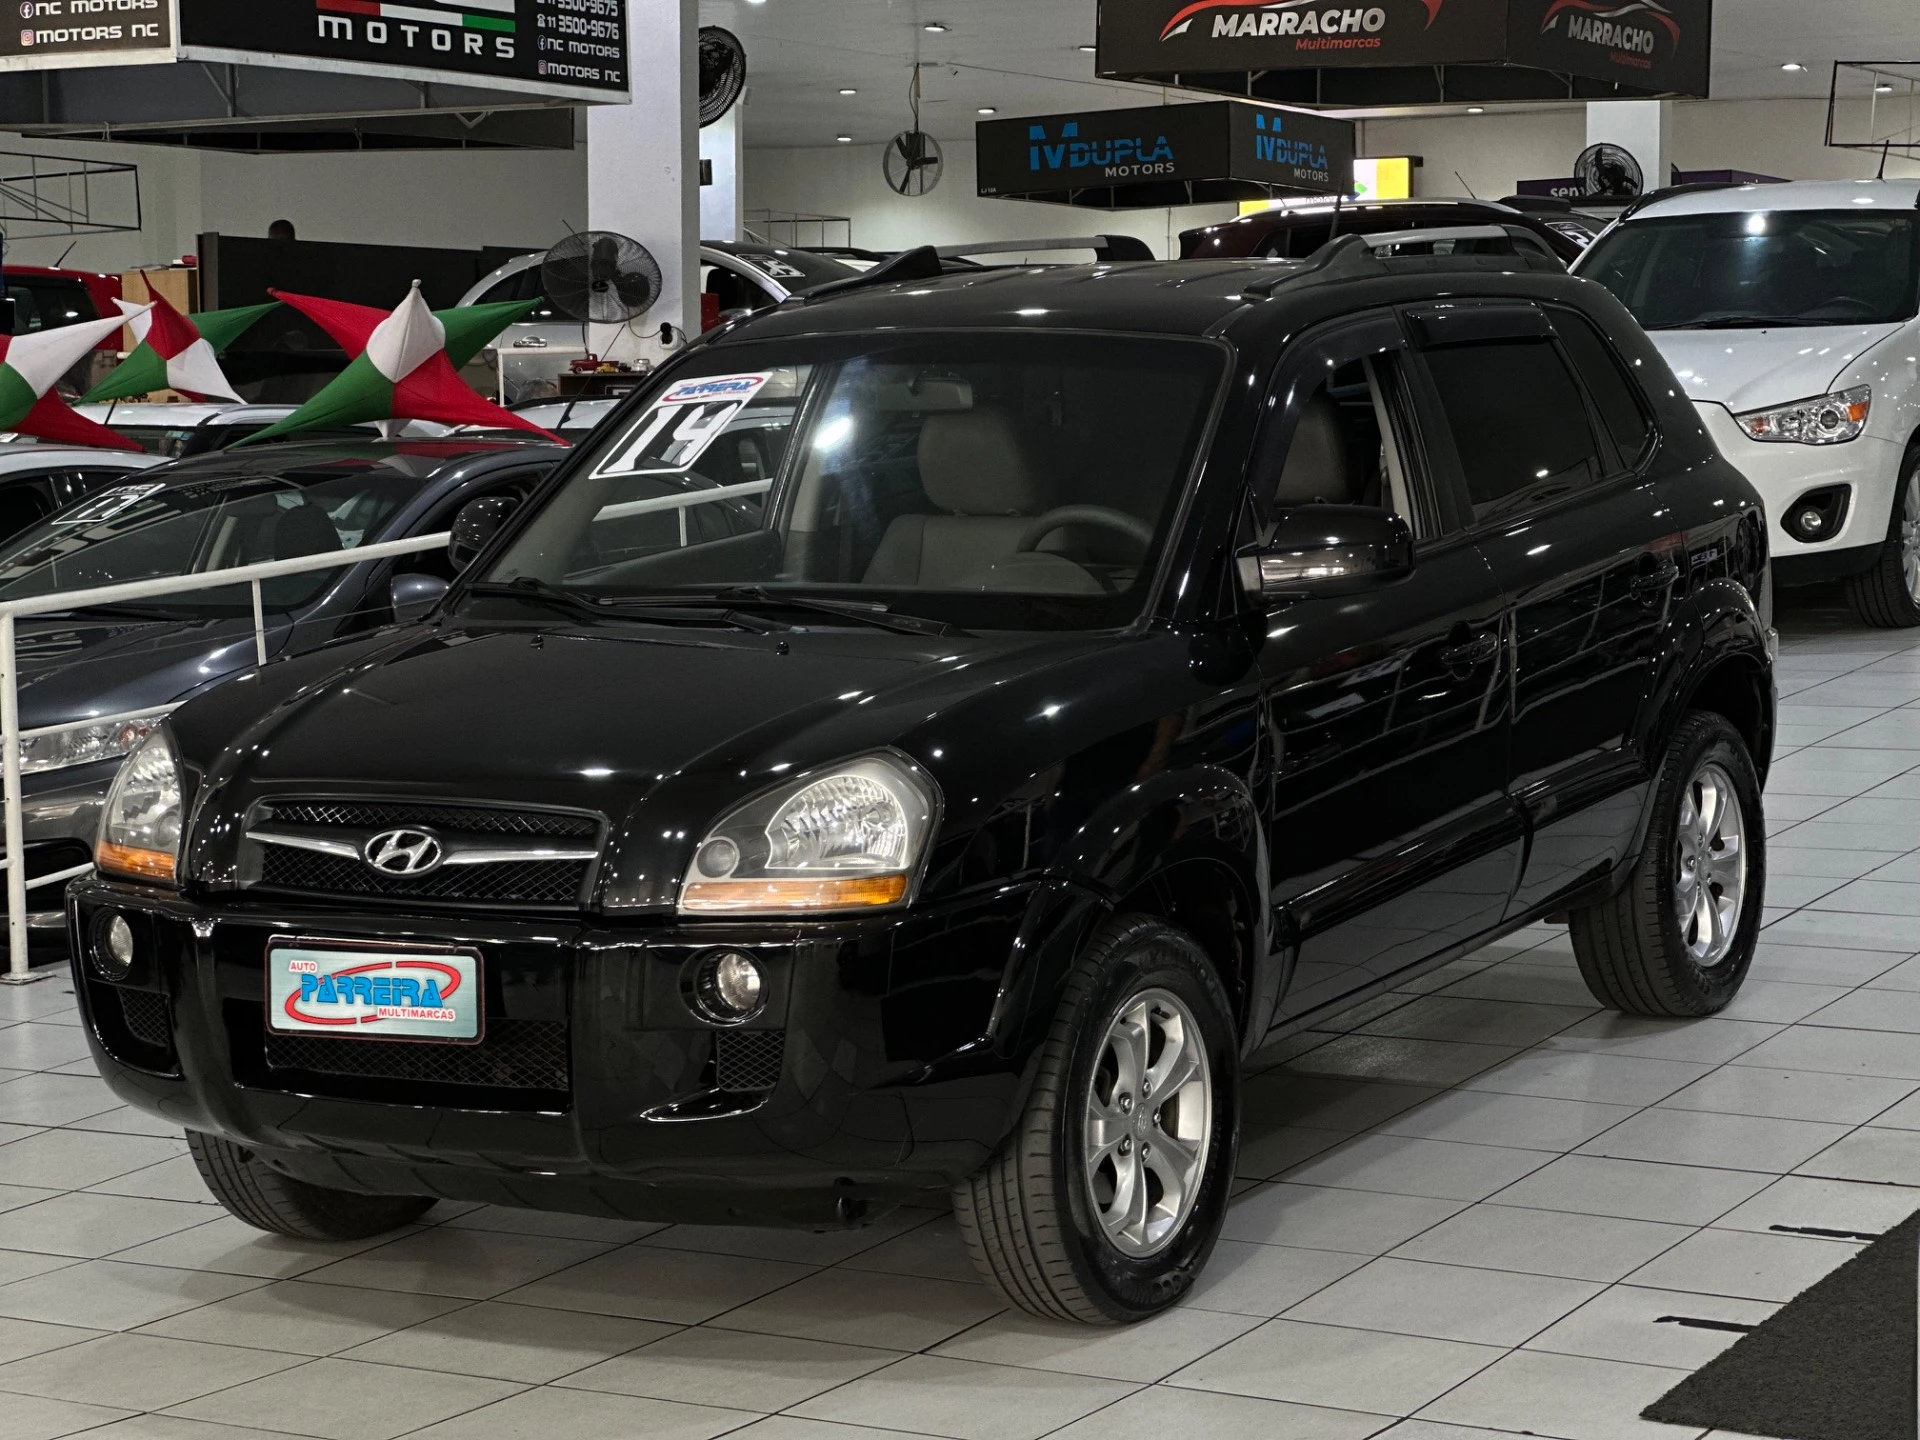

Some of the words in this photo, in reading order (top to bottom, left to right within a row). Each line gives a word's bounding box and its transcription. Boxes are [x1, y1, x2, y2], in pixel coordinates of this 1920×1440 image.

[35, 2, 62, 16] NC
[70, 0, 158, 13] MOTORS
[558, 15, 619, 40] 3500-9676
[1211, 7, 1386, 38] MARRACHO
[36, 25, 122, 44] MOTORS
[131, 23, 159, 37] NC
[317, 14, 515, 59] MOTORS
[1295, 36, 1381, 51] Multimarcas
[1567, 14, 1654, 54] MARRACHO
[547, 38, 563, 51] NC
[568, 41, 620, 58] MOTORS
[547, 62, 600, 80] MOTORS
[605, 69, 621, 83] NC
[1105, 162, 1175, 178] MOTORS
[1293, 167, 1329, 182] MOTORS
[289, 961, 317, 972] AUTO
[301, 973, 444, 1008] PARREIRA
[378, 1007, 455, 1020] MULTIMARCAS
